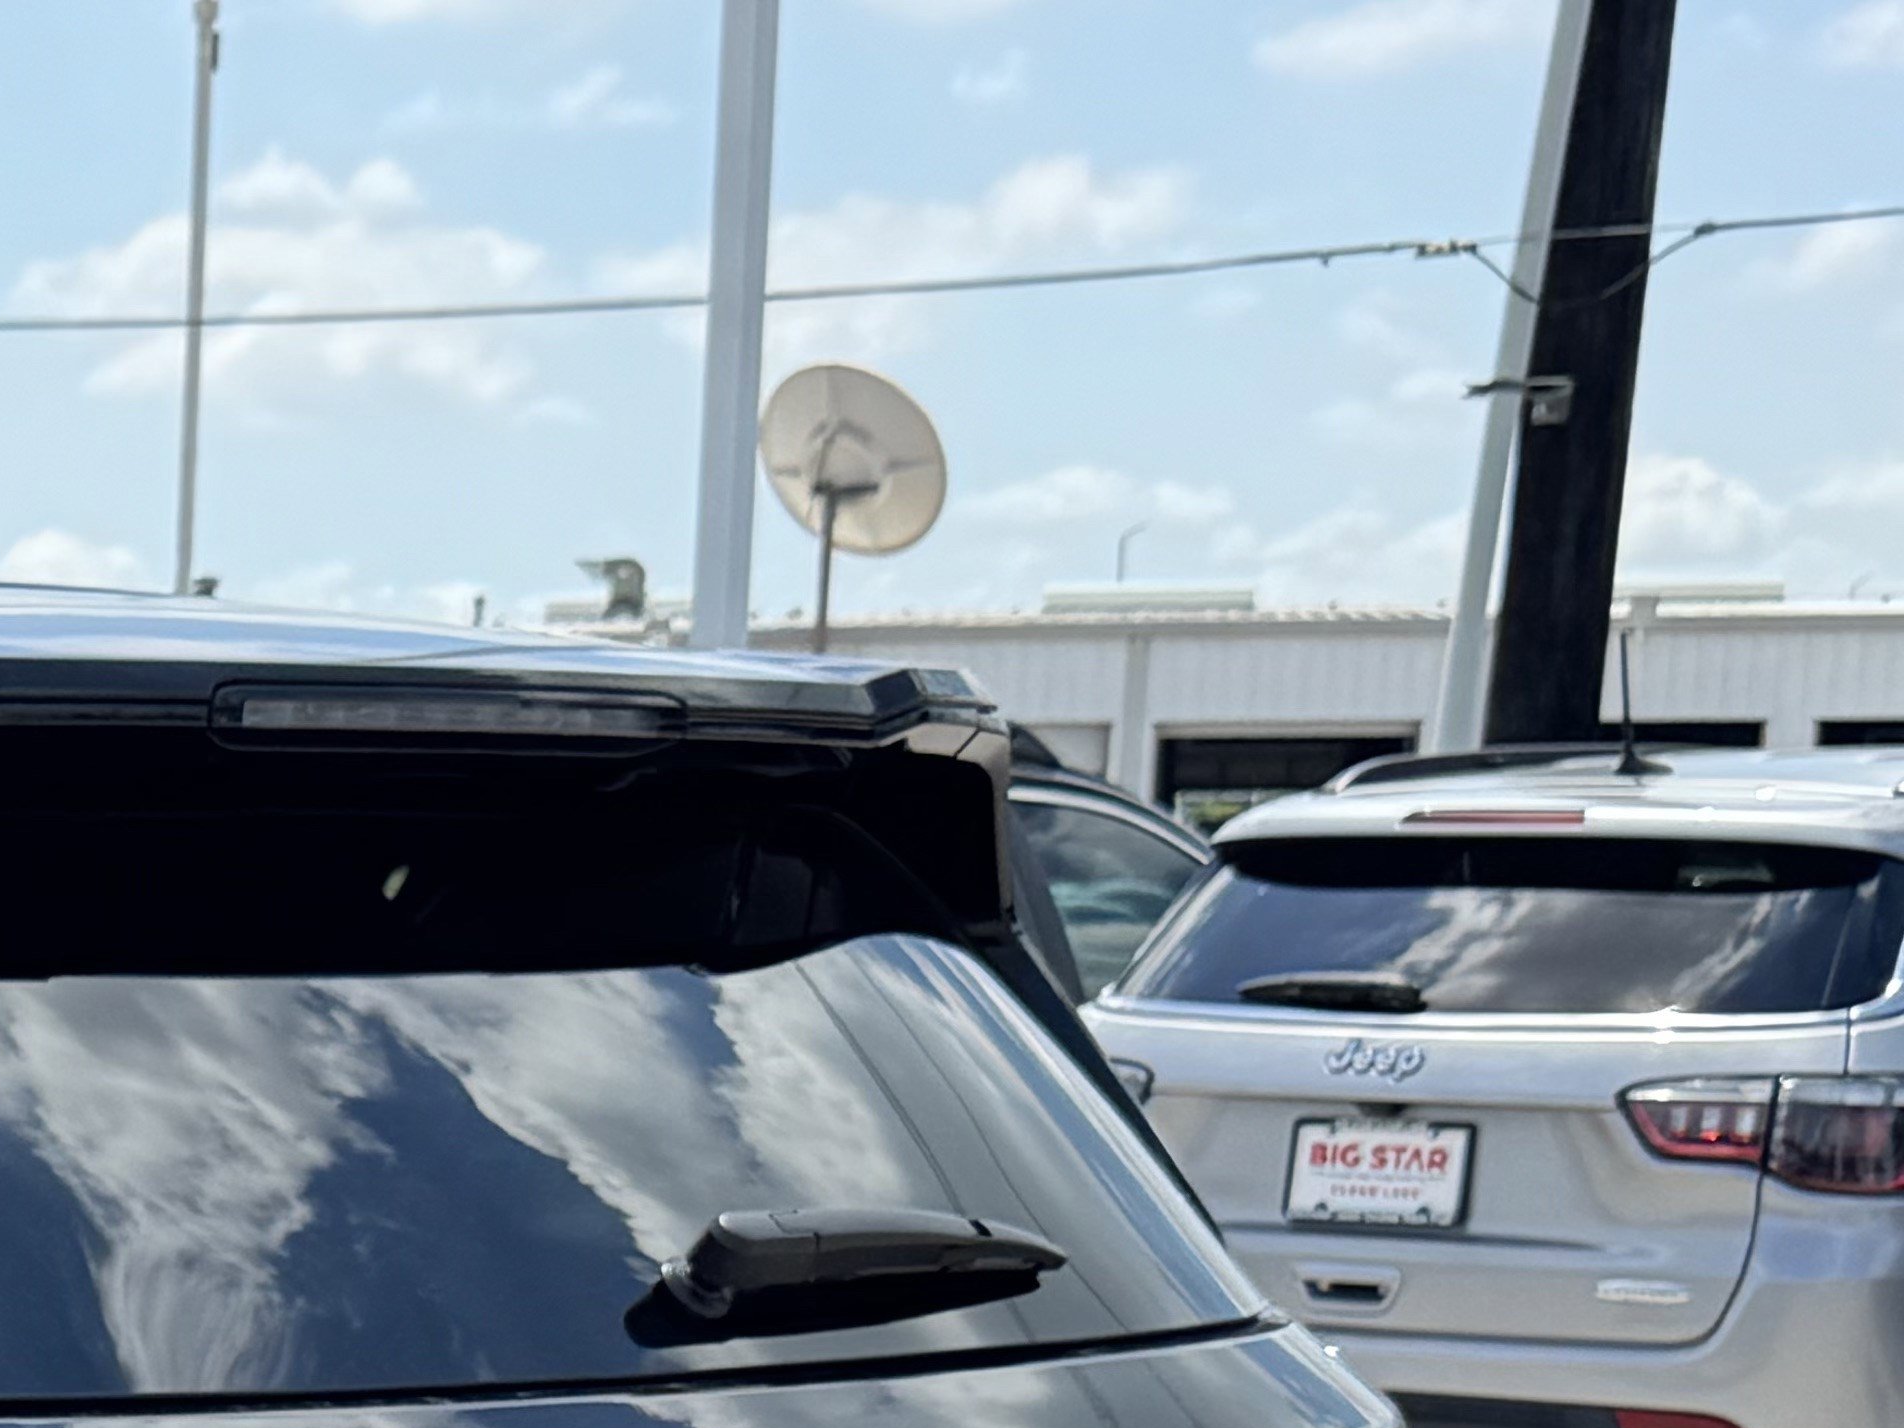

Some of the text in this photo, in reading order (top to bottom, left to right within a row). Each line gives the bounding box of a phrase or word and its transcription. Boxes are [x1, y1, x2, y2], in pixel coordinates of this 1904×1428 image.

[1324, 1038, 1425, 1083] Jeep
[1310, 1141, 1449, 1174] BIG STAR
